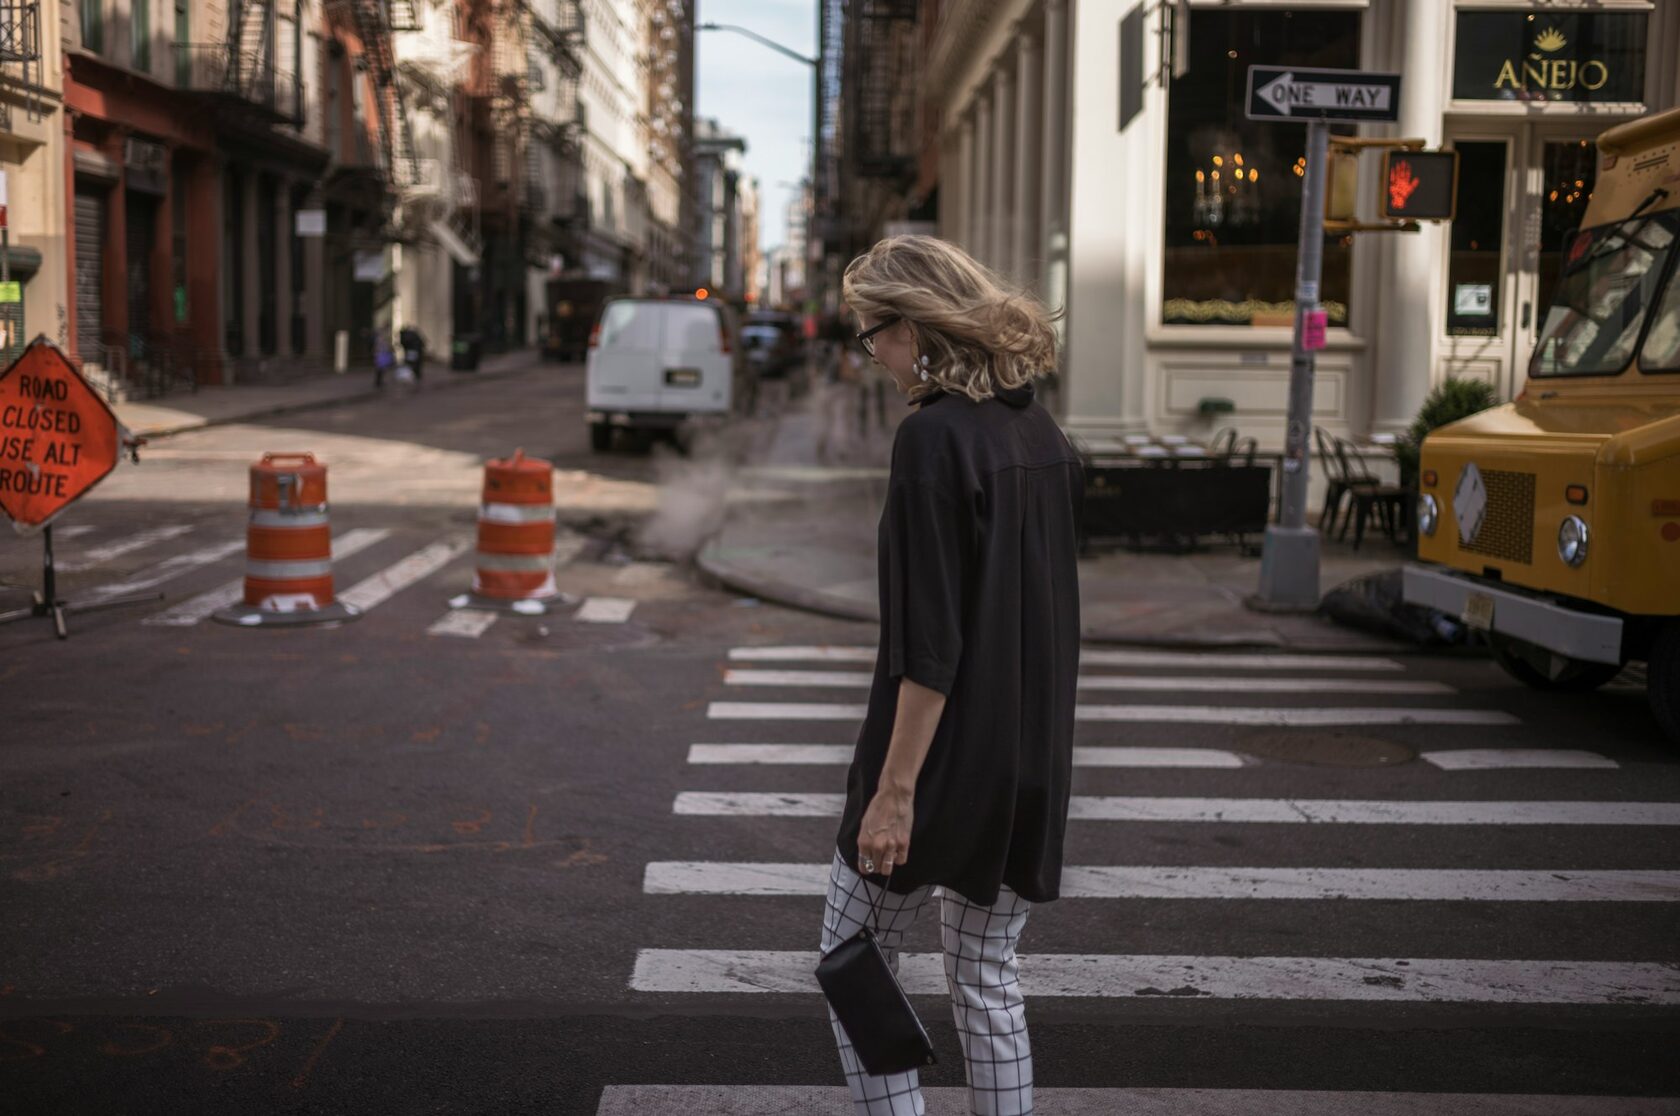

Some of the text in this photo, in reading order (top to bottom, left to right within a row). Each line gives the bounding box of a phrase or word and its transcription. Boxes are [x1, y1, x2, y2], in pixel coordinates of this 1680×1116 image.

[1494, 53, 1608, 90] AÑEJO
[1272, 83, 1381, 107] ONE WAY
[20, 375, 68, 401] ROAD
[2, 405, 81, 434] CLOSED
[43, 442, 81, 466] ALT
[0, 469, 69, 498] ROUTE
